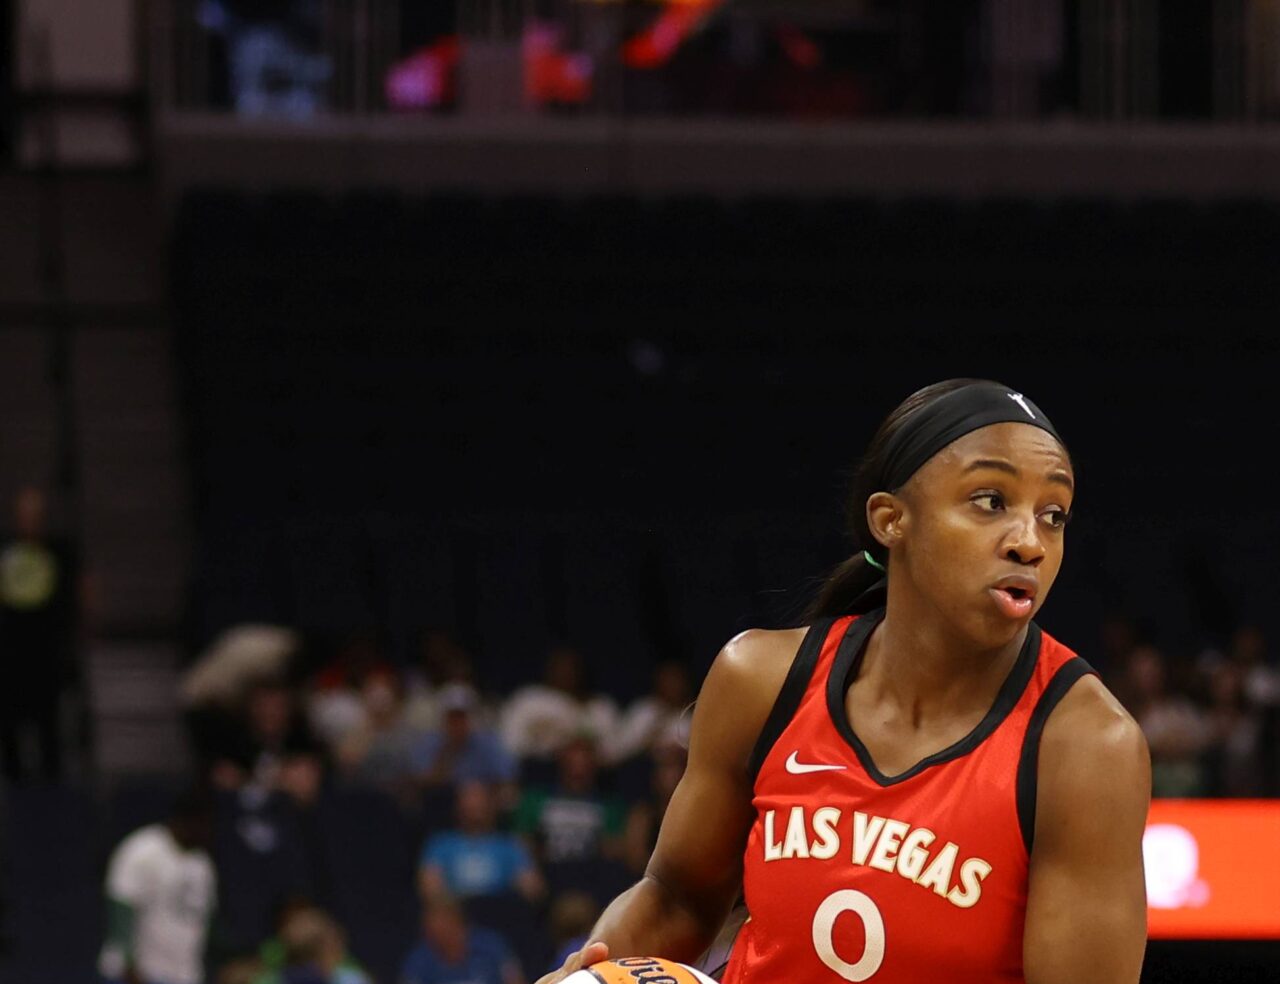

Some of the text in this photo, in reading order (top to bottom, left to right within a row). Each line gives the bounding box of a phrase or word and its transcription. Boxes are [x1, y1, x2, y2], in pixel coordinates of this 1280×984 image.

[764, 806, 993, 908] LAS VEGAS
[812, 888, 886, 983] 0
